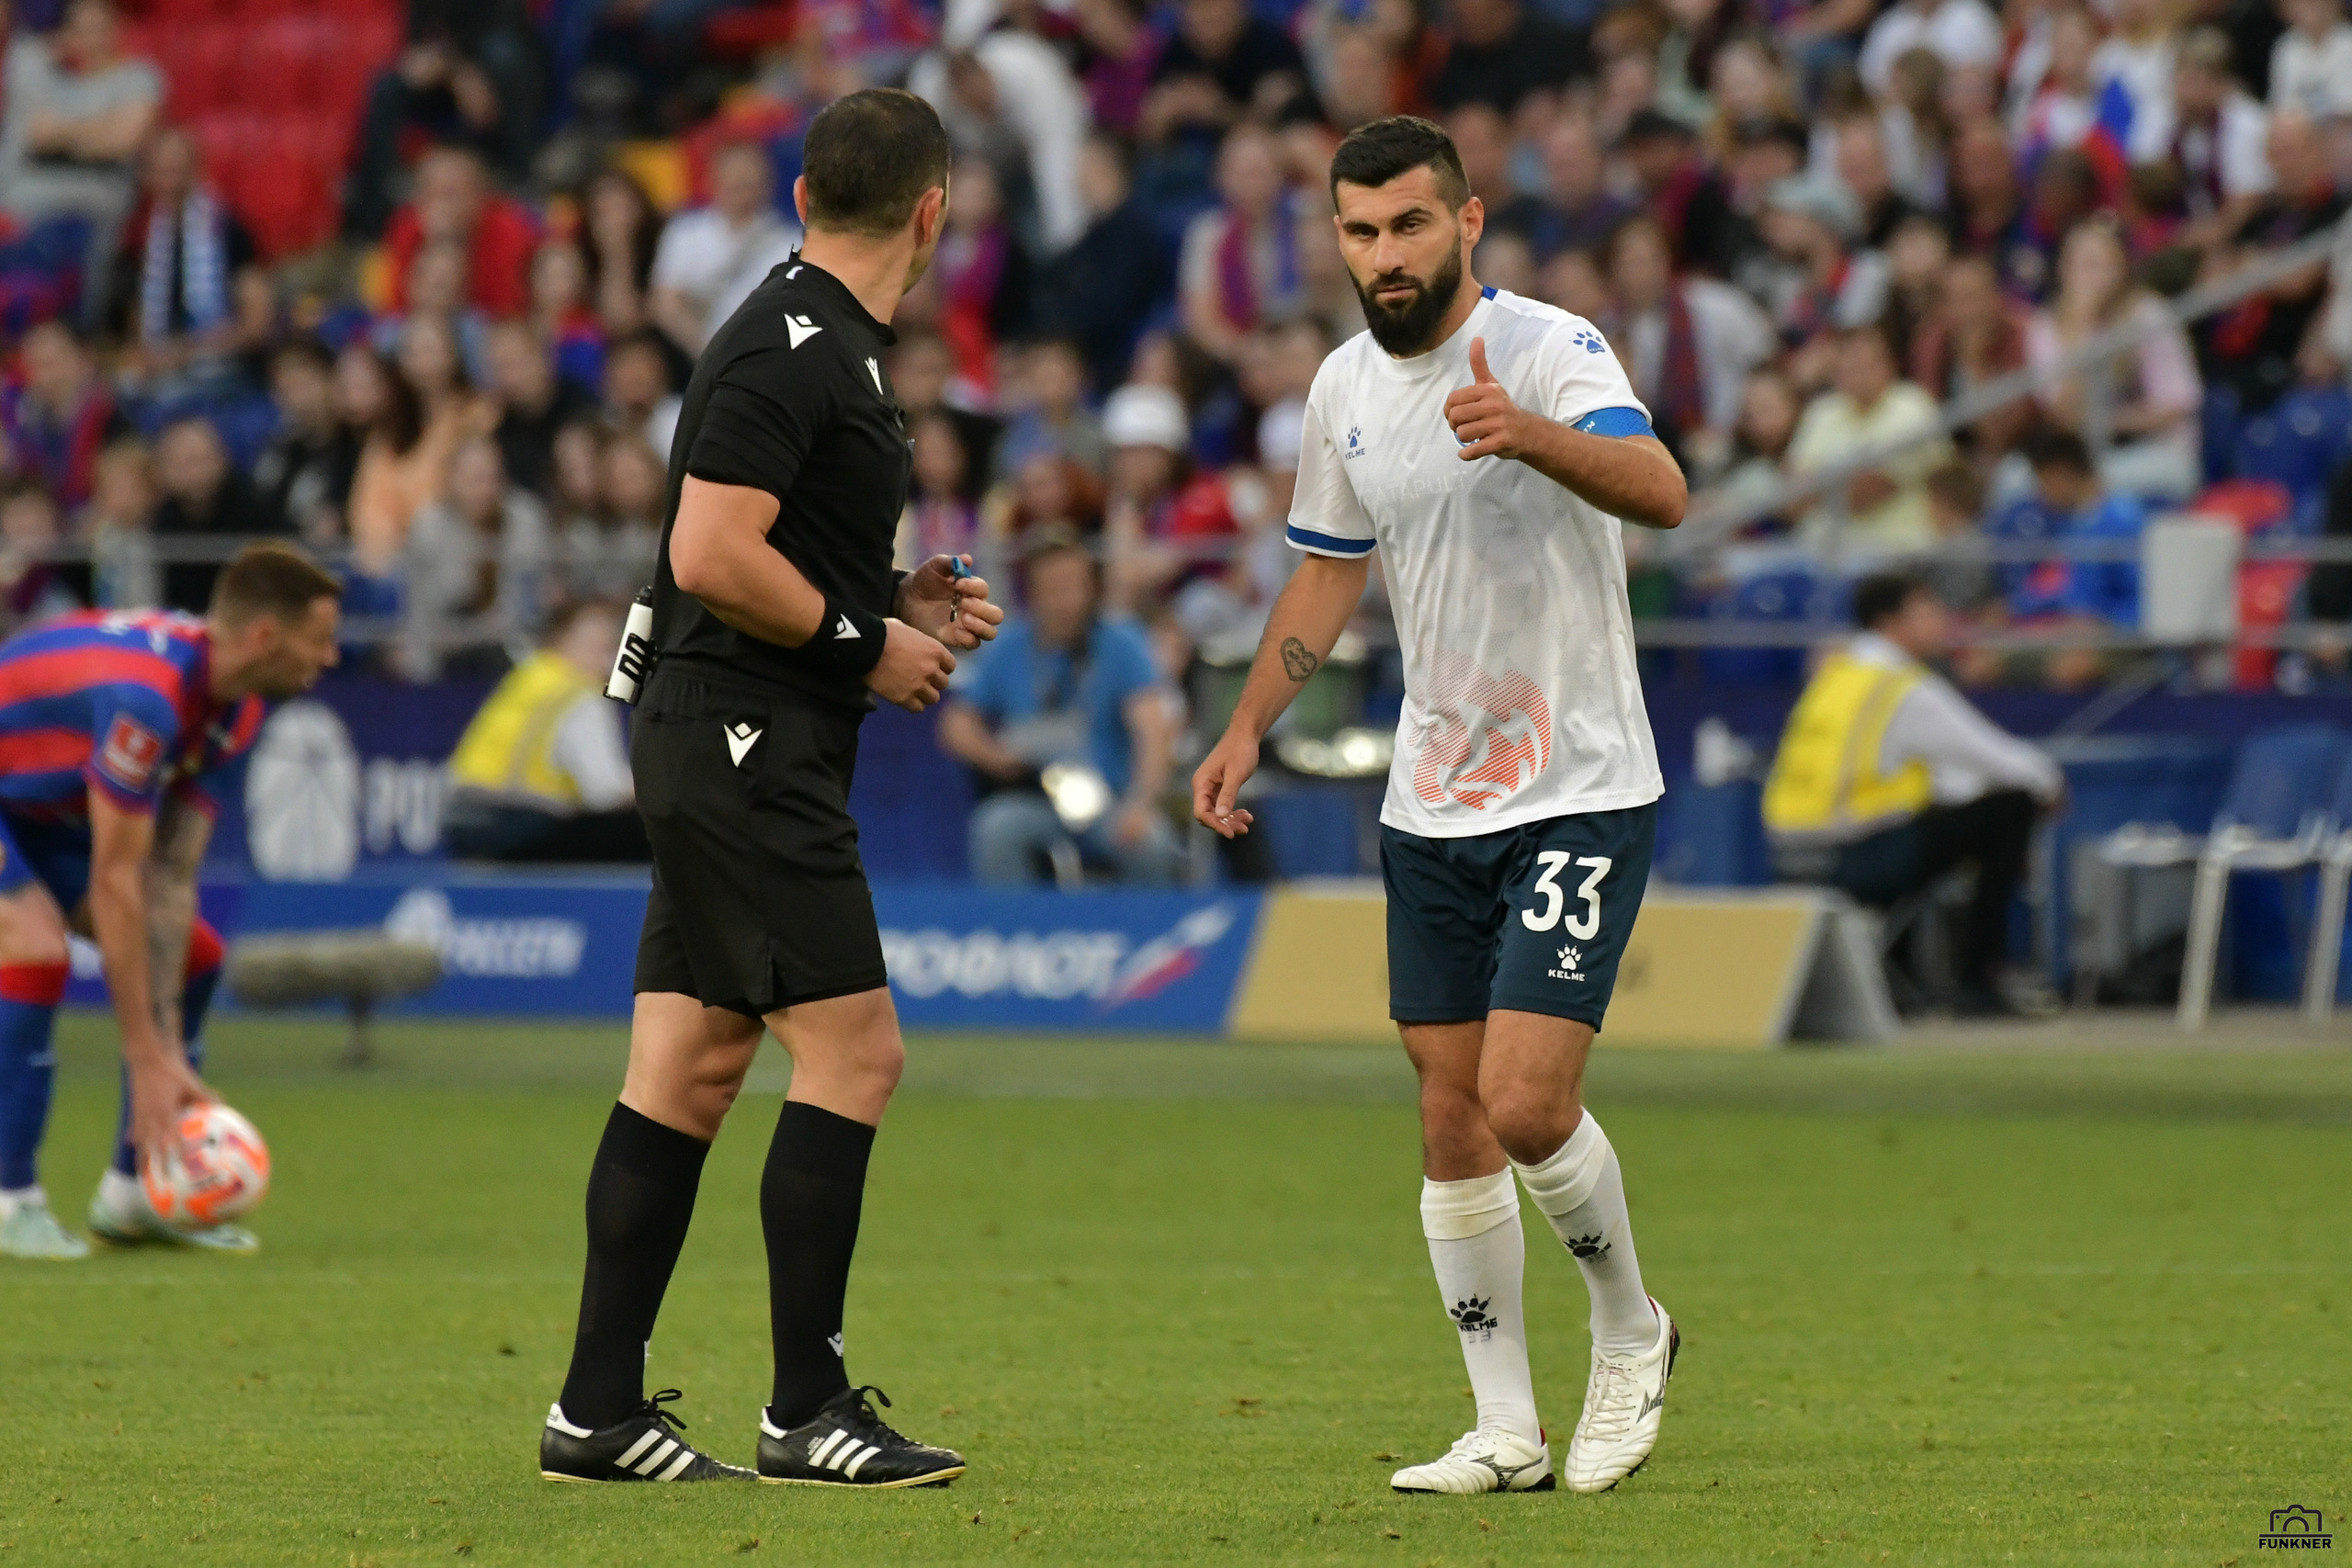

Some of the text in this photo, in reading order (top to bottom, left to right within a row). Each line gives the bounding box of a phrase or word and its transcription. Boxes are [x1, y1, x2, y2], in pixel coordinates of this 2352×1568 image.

[1521, 851, 1612, 941] 33
[1547, 969, 1585, 982] KELME
[1460, 1317, 1498, 1332] KELME
